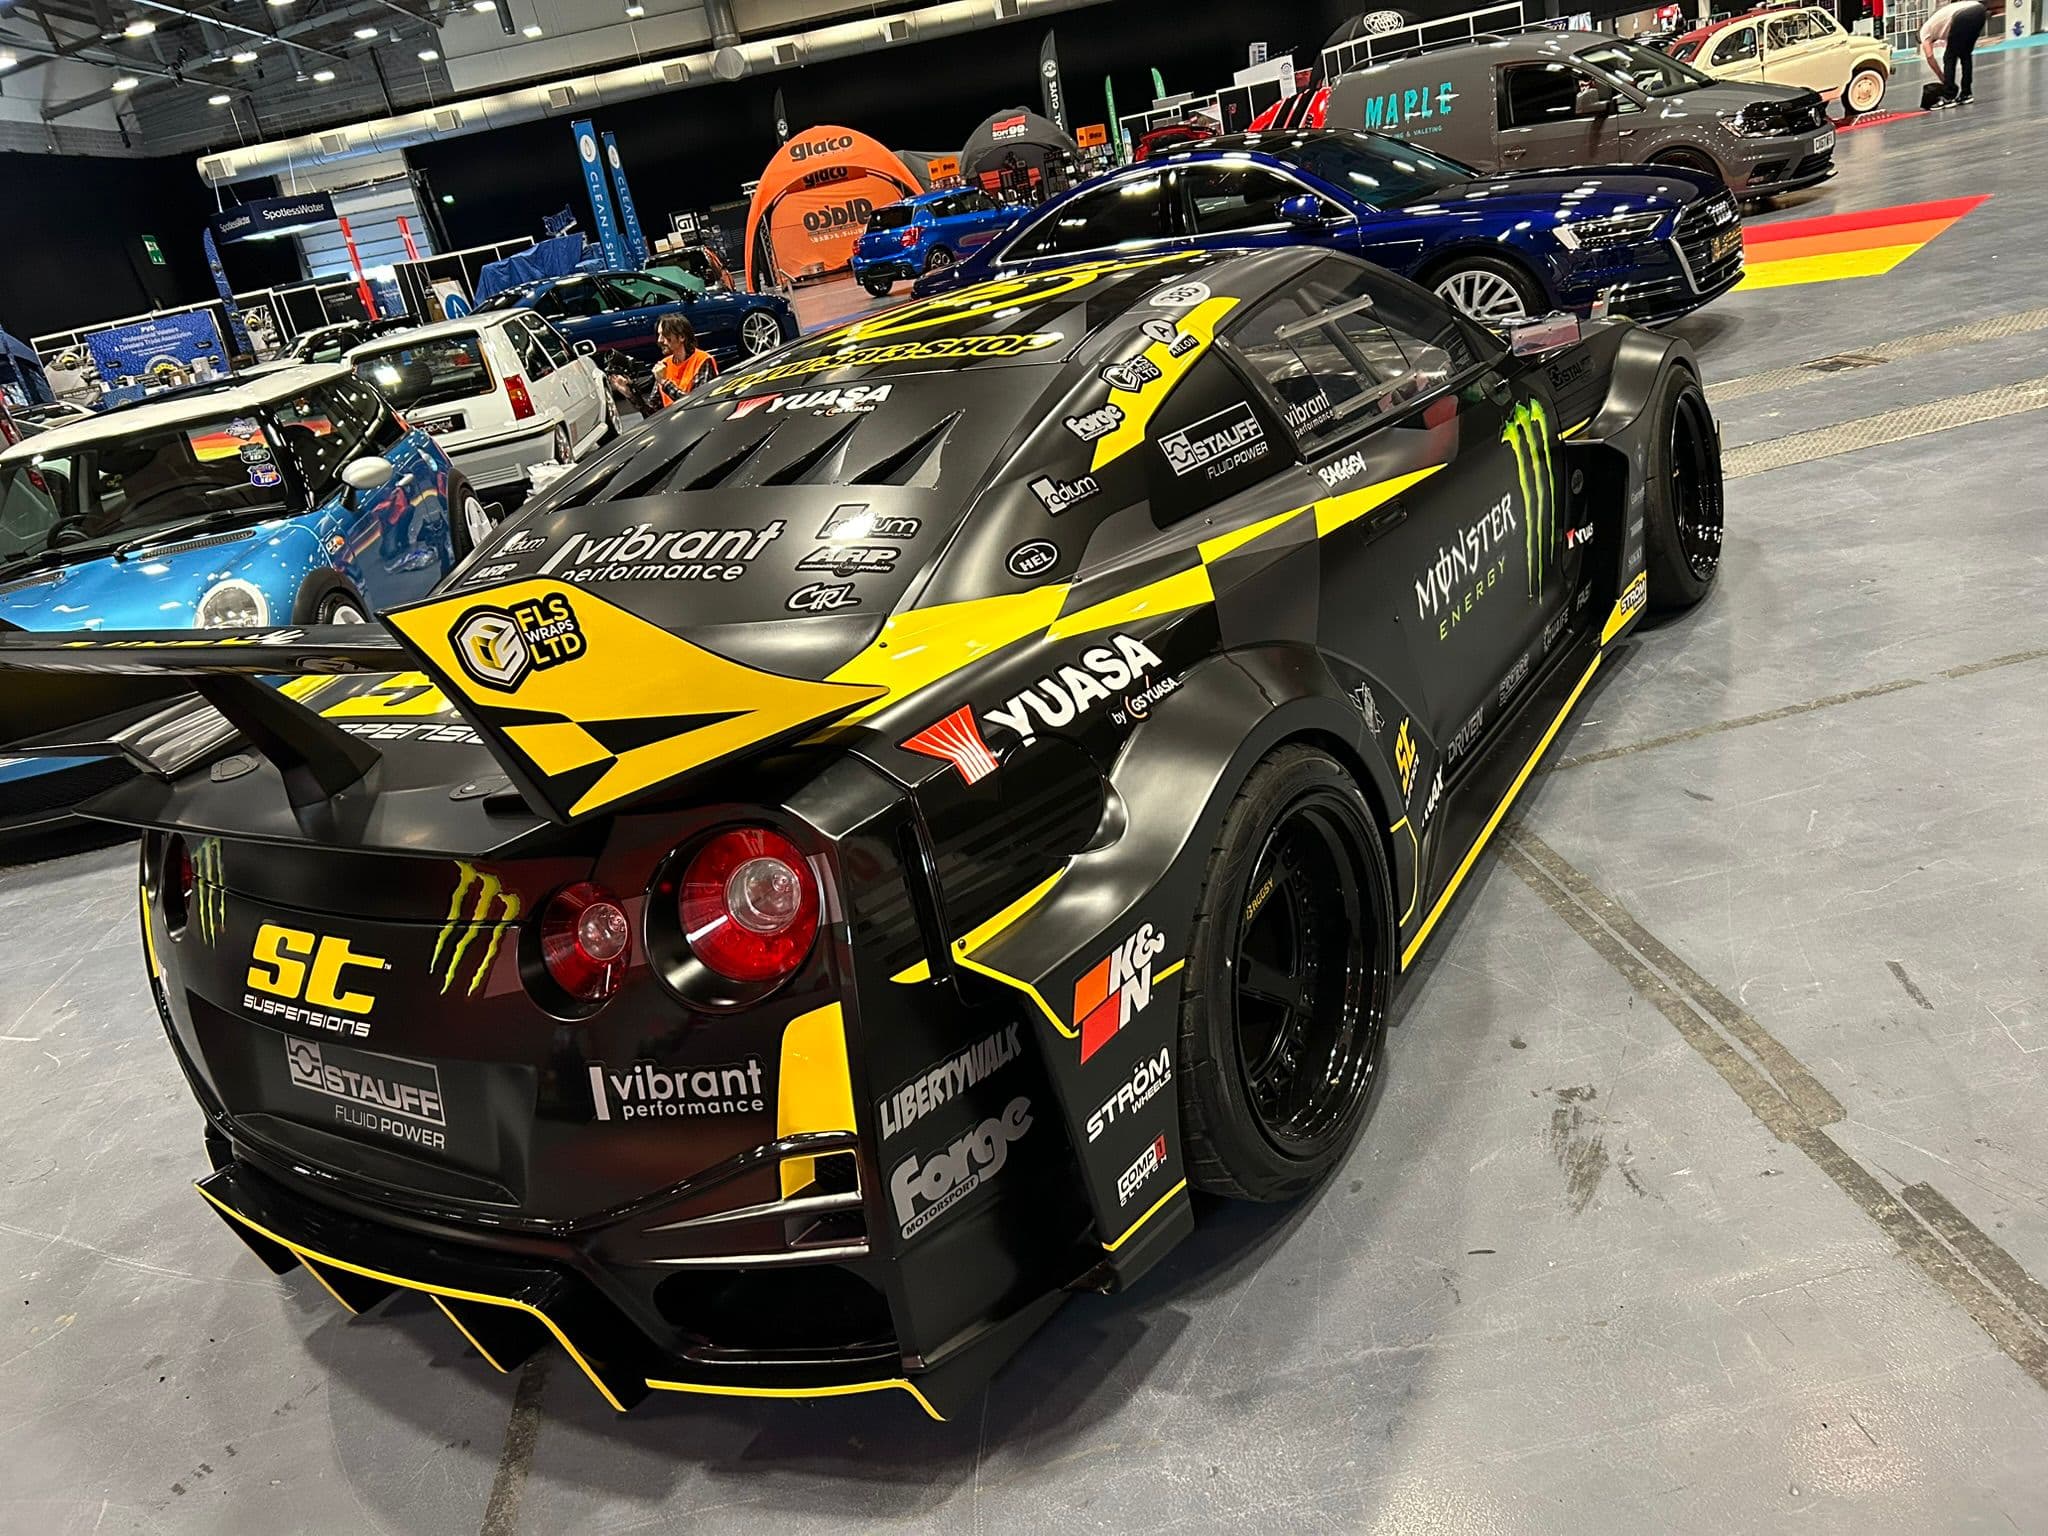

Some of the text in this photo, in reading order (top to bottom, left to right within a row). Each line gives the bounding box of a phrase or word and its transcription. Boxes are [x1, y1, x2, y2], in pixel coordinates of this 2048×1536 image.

[1366, 81, 1453, 130] MAPLE
[789, 135, 854, 162] glaco
[262, 202, 325, 221] SpotlessWater
[589, 171, 609, 228] CLEAN
[616, 176, 636, 226] CLEAN
[1153, 324, 1168, 338] A
[1171, 336, 1198, 356] ARLON
[1137, 367, 1159, 381] LTD
[766, 384, 893, 414] YUASA
[1284, 387, 1331, 428] vibrant
[1191, 417, 1259, 459] STAUFF
[1294, 409, 1334, 440] performance
[1206, 441, 1269, 480] FLUID POWER
[1318, 451, 1368, 488] BAGGSY
[576, 522, 786, 566] vibrant
[803, 548, 898, 562] ARP
[1019, 551, 1053, 572] HEL
[469, 562, 519, 580] ARP
[562, 562, 743, 582] performance
[515, 599, 569, 632] FLS
[788, 584, 859, 610] CTRL
[1439, 556, 1505, 641] ENERGY
[525, 619, 575, 643] WRAPS
[530, 632, 581, 664] LTD
[983, 634, 1163, 748] YUASA
[1111, 710, 1128, 725] by
[1447, 706, 1484, 765] DRIVEN
[1246, 876, 1275, 920] BAGGSY
[324, 1064, 441, 1117] STAUFF
[609, 1059, 762, 1101] vibrant
[879, 1021, 1022, 1141] LIBERTYWALK
[1086, 1047, 1171, 1144] STRÖM
[1131, 1069, 1172, 1115] WHEELS
[335, 1104, 446, 1150] FLUID POWER
[622, 1099, 764, 1121] performance
[1120, 1155, 1168, 1208] CLUTCH
[905, 1176, 976, 1236] MOTORSPORT
